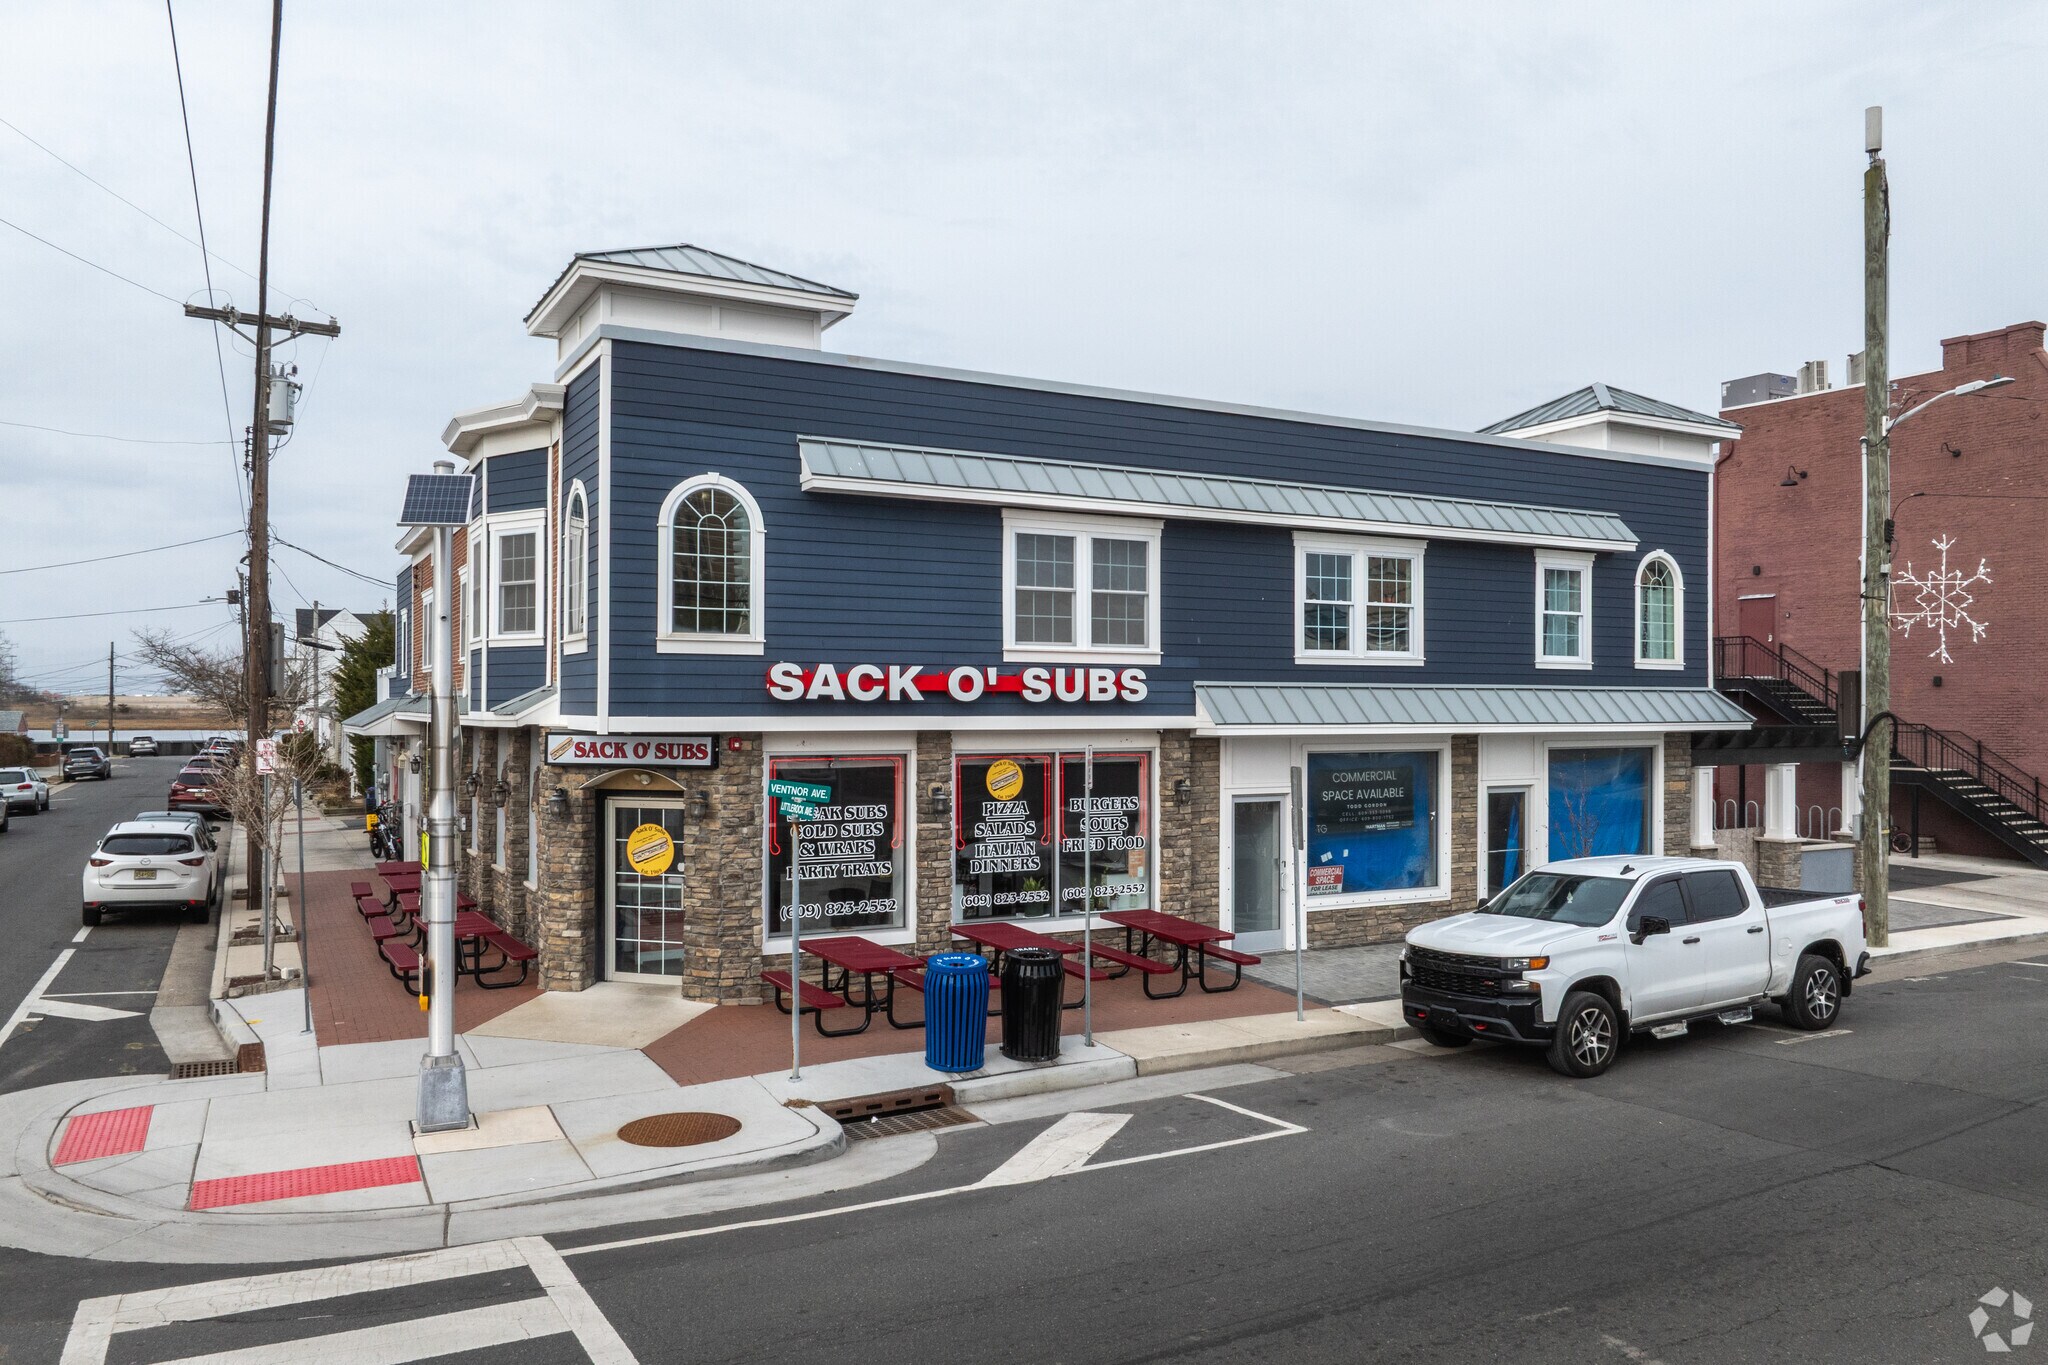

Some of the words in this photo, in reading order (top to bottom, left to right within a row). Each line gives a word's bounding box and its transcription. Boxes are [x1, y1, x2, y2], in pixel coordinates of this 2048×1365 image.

[769, 662, 925, 701] SACK
[947, 666, 998, 702] O'
[1022, 667, 1148, 702] SUBS
[574, 741, 628, 759] SACK
[633, 741, 652, 759] O'
[654, 743, 709, 760] SUBS
[1332, 770, 1397, 783] COMMERCIAL
[770, 783, 809, 797] VENTNOR
[810, 788, 828, 799] AVE.
[1322, 789, 1354, 801] SPACE
[1356, 787, 1404, 799] AVAILABLE
[780, 801, 805, 815] LITTLEROCK
[844, 804, 888, 820] SUBS
[982, 801, 1029, 816] PIZZA
[841, 822, 885, 838] SUBS
[975, 821, 1036, 837] SALADS
[799, 842, 815, 857] &
[817, 840, 876, 856] WRAPS
[975, 841, 1036, 858] ITALIAN
[1107, 836, 1145, 850] FOOD
[841, 861, 893, 877] TRAYS
[970, 857, 1041, 874] DINNERS
[1310, 867, 1342, 877] COMMERCIAL
[1315, 875, 1335, 885] SPACE
[1093, 883, 1146, 897] 823-2552
[825, 899, 897, 916] 823-2552
[960, 894, 992, 909] (609)
[993, 890, 1050, 905] 823-2552
